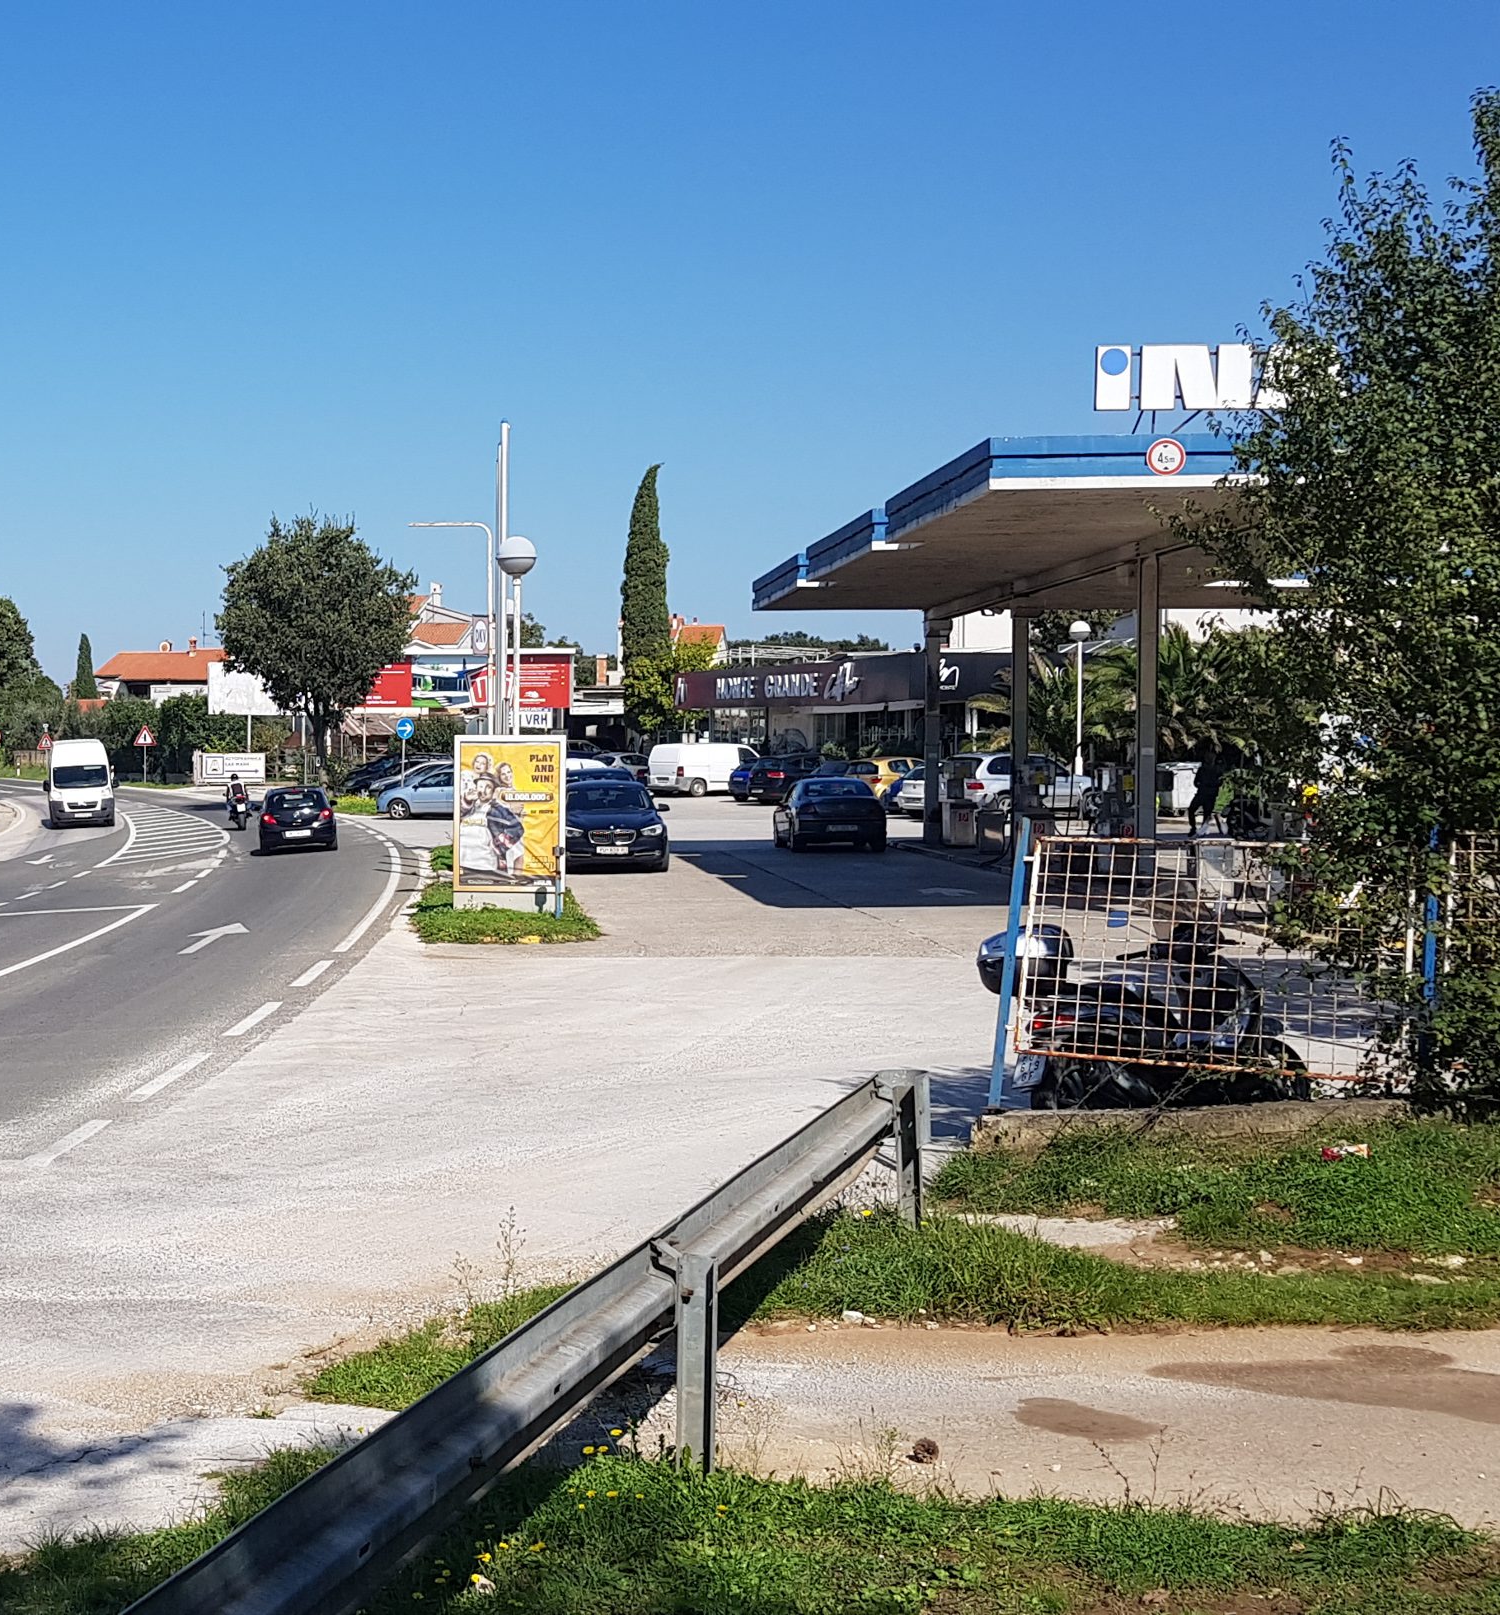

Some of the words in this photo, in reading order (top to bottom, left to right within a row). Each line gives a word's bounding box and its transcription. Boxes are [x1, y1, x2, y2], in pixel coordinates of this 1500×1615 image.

[475, 628, 486, 643] DKV
[764, 673, 820, 698] GRANDE
[525, 713, 548, 726] VRH
[529, 754, 555, 763] PLAY
[534, 764, 555, 773] AND
[531, 774, 554, 783] WIN!
